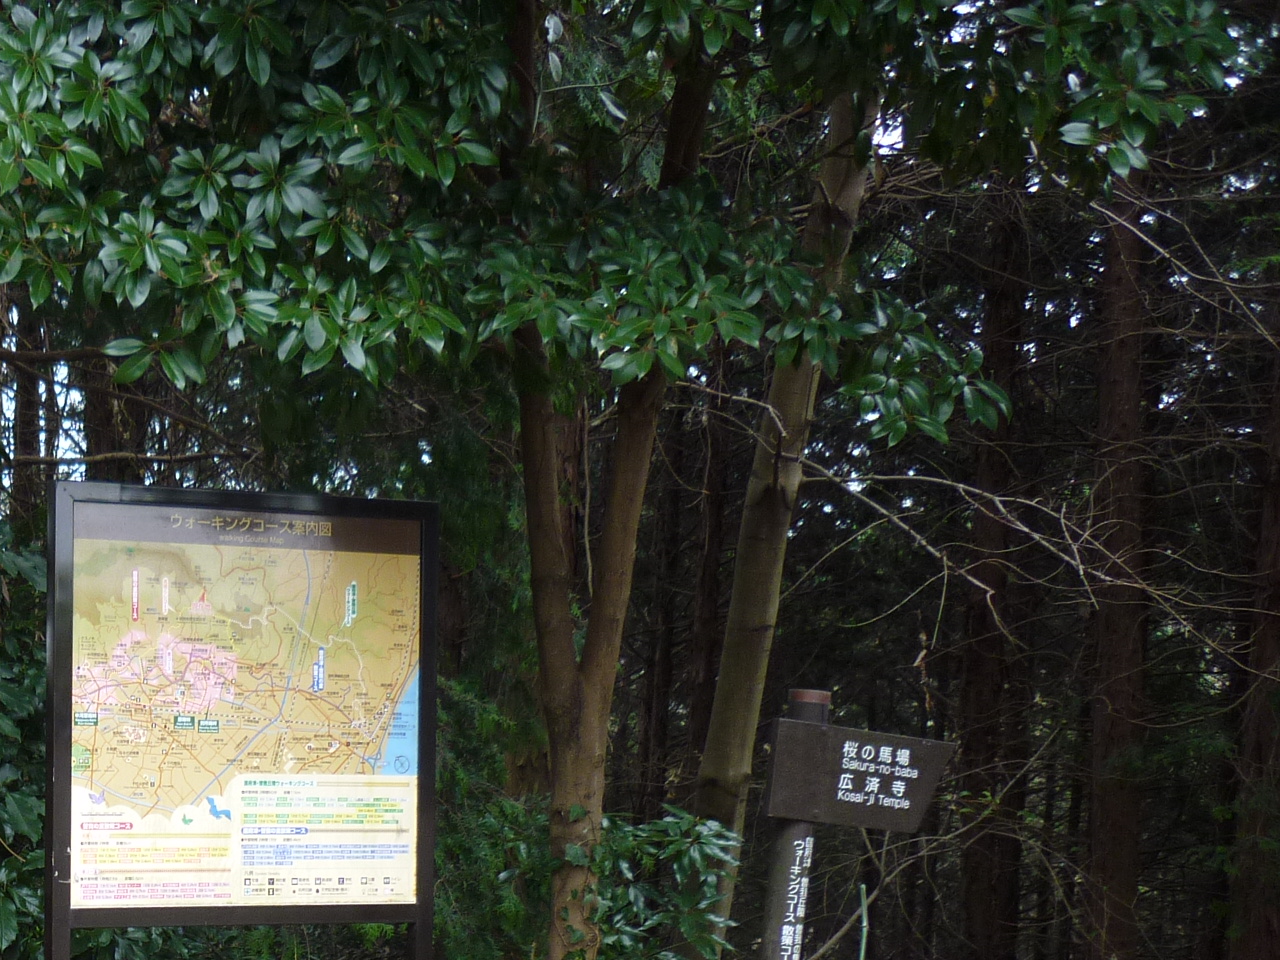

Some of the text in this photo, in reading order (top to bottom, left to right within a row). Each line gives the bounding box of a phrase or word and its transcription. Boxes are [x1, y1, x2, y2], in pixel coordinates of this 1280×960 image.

[170, 514, 332, 537] ウォーキングコース案内図
[842, 741, 910, 766] 桜の馬場
[842, 757, 919, 779] Sakura-no-baba
[838, 773, 907, 797] 広済寺
[837, 789, 910, 809] Kosai-ji Temple
[784, 840, 805, 922] ウォーキングコース
